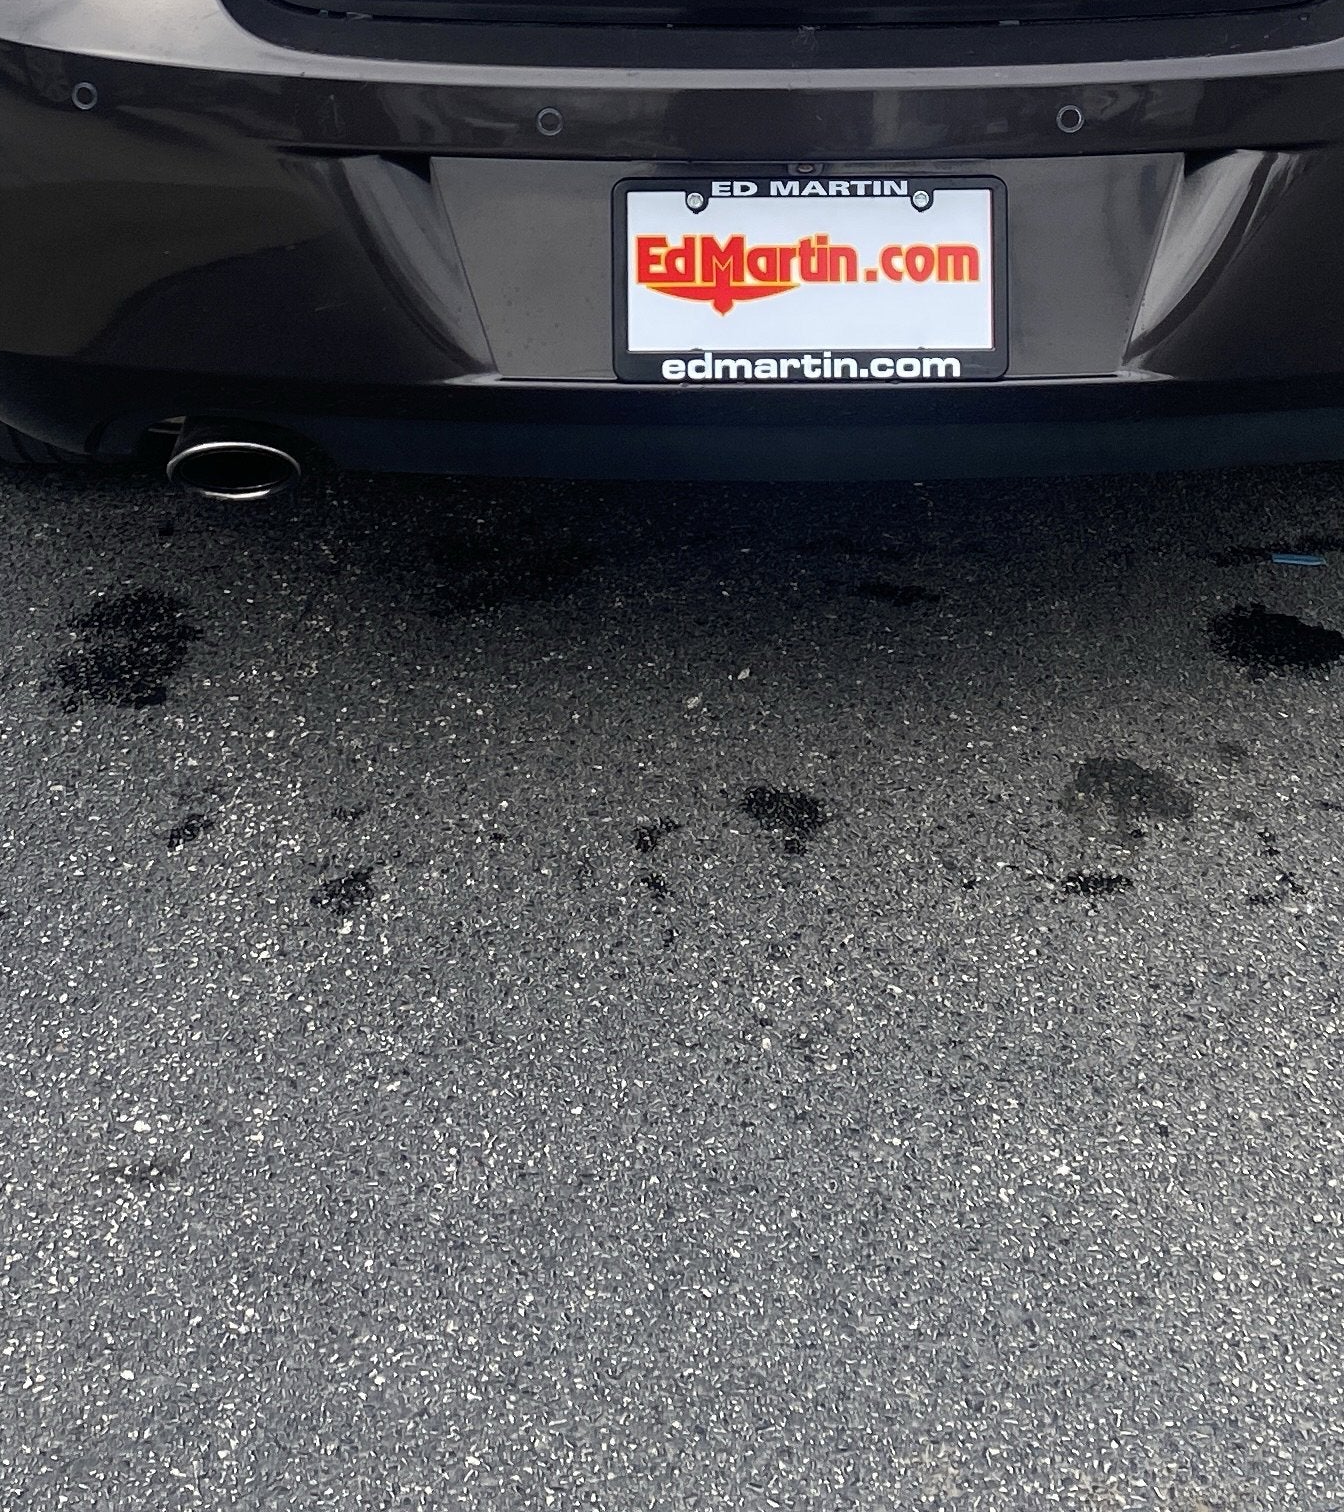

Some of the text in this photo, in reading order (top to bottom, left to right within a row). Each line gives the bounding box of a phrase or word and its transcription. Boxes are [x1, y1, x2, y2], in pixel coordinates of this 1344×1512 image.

[711, 180, 909, 197] ED MARTIN
[634, 232, 981, 284] EdMartin.com
[661, 351, 961, 380] edmartin.com
